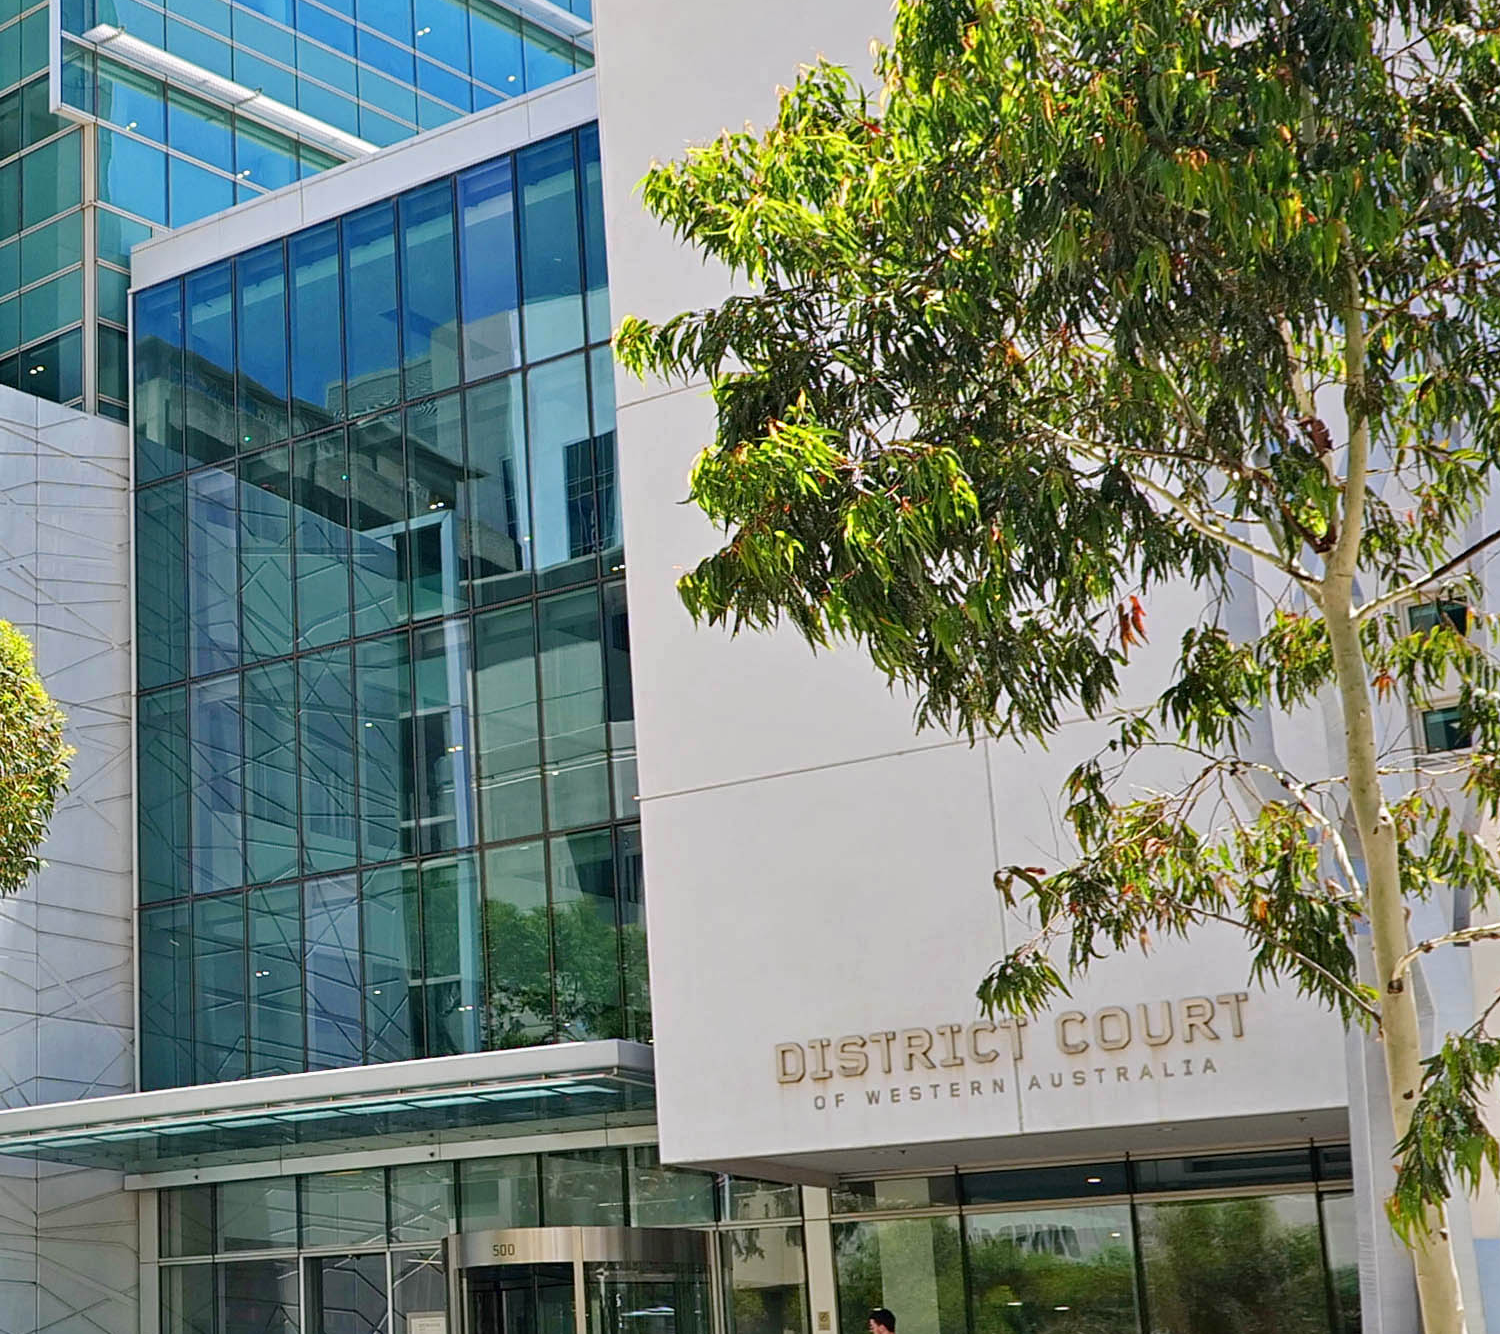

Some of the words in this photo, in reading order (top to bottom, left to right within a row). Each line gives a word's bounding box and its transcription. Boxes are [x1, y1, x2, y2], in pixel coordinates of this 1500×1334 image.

[775, 1017, 1028, 1084] DISTRICT
[1055, 992, 1249, 1055] COURT
[814, 1093, 845, 1110] OF
[866, 1078, 1005, 1105] WESTERN
[1028, 1058, 1217, 1091] AUSTRALIA
[492, 1244, 515, 1257] 500
